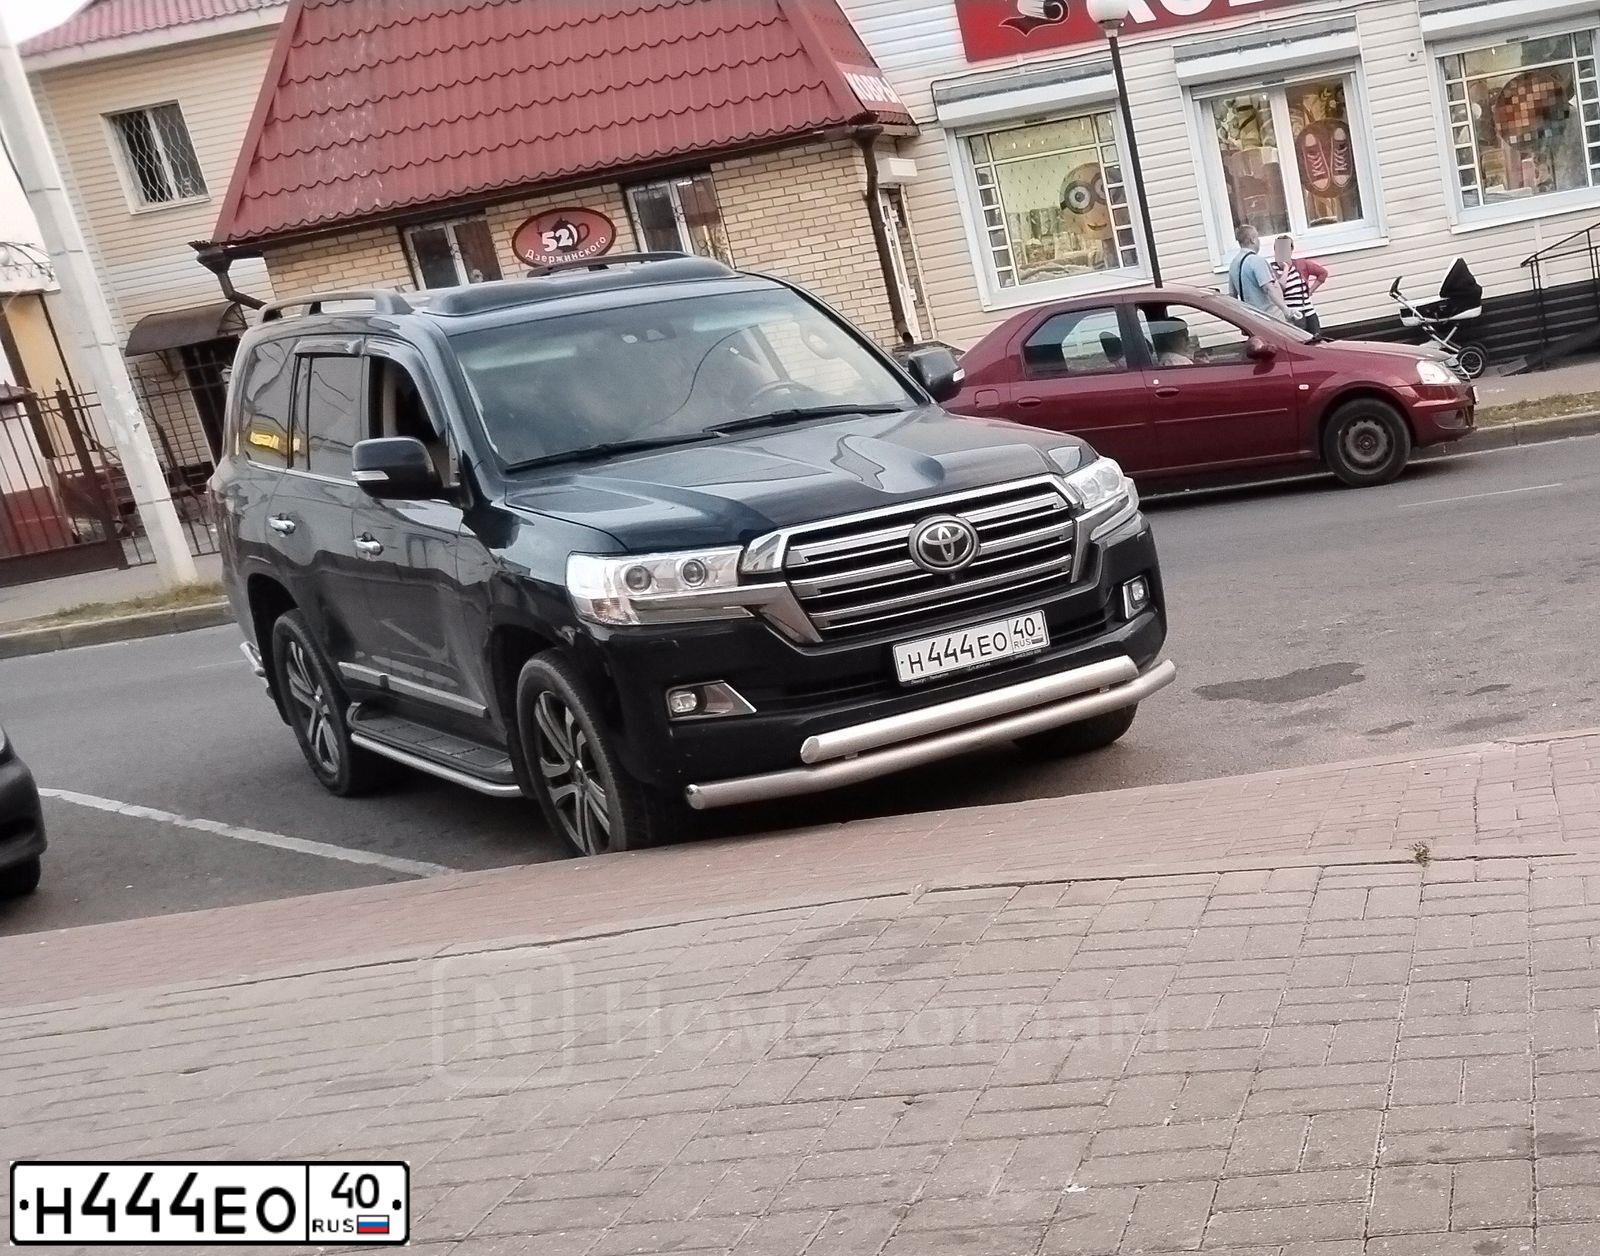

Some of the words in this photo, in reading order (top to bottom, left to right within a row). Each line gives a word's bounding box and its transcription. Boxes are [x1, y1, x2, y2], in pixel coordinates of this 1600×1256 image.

[525, 236, 607, 264] Дзержинского
[1013, 617, 1035, 637] 40
[1013, 638, 1032, 649] RUS
